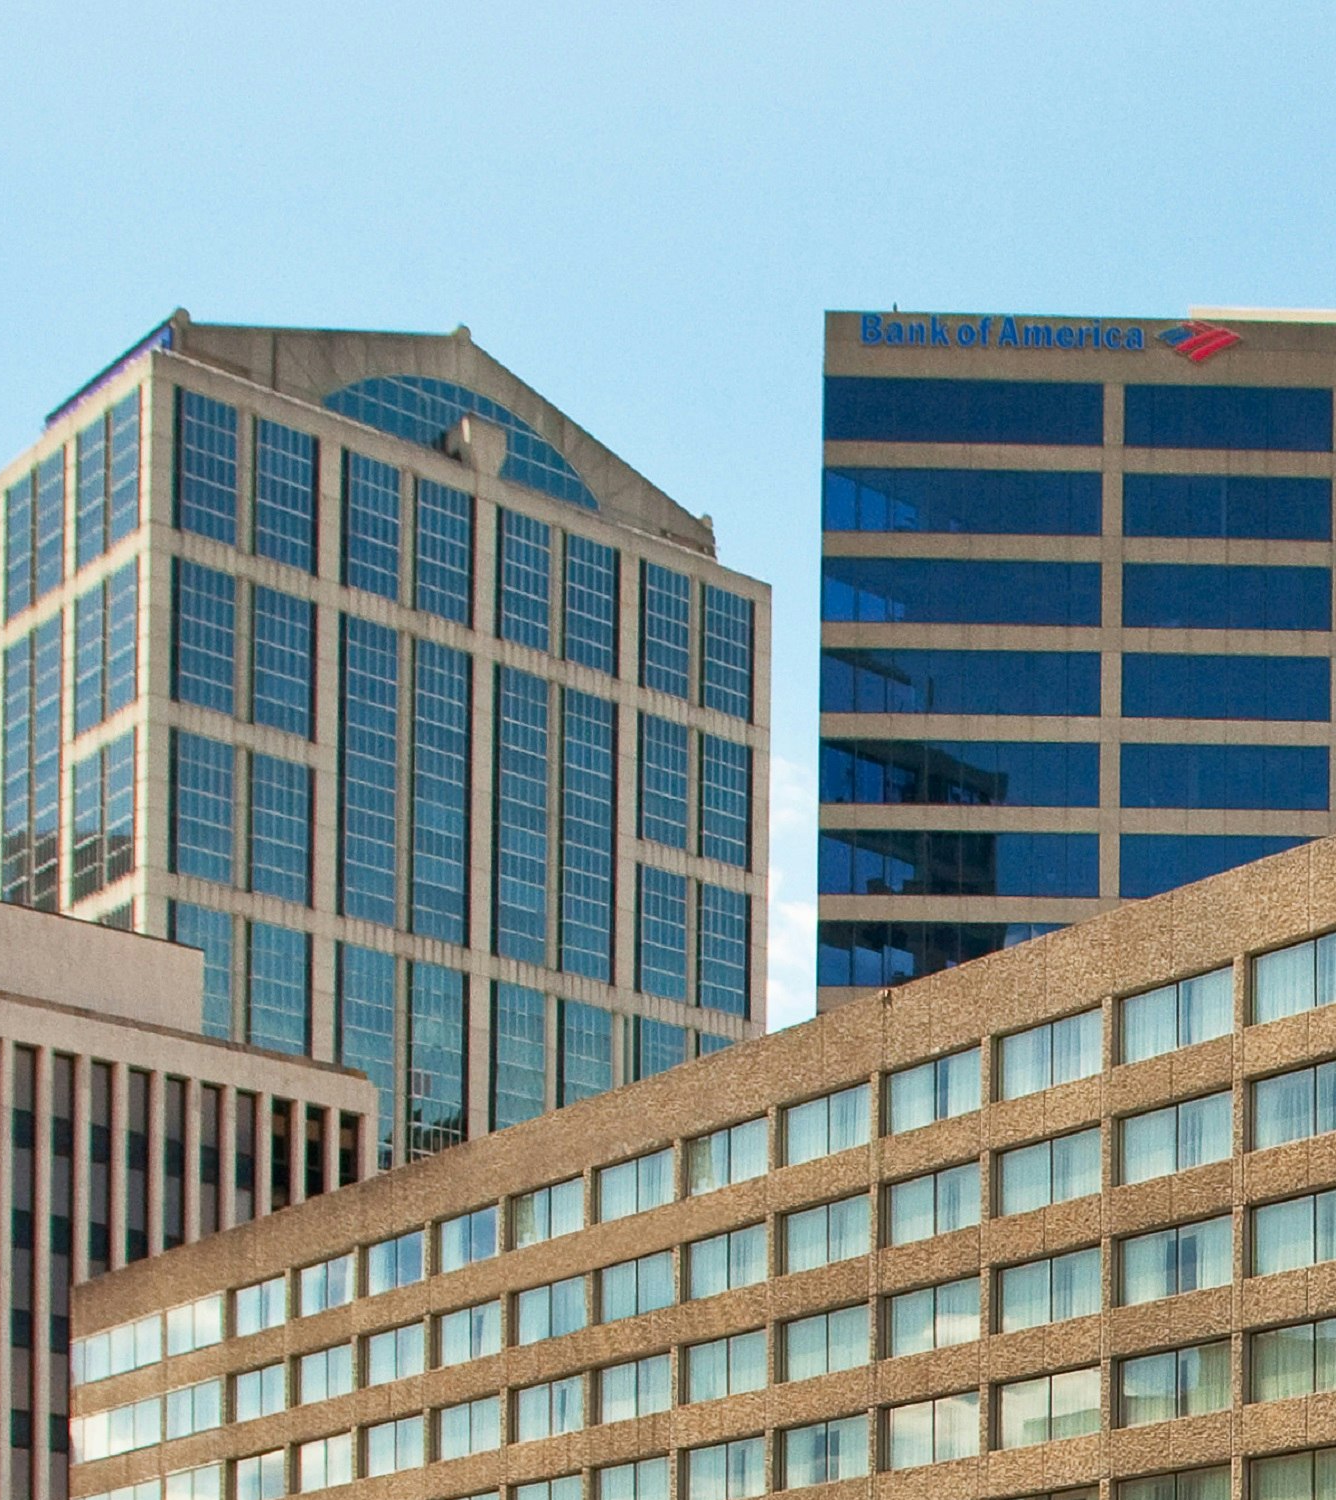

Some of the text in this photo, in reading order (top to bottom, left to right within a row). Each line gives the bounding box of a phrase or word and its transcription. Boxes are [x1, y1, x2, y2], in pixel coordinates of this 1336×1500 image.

[861, 314, 1145, 350] Bank of America
